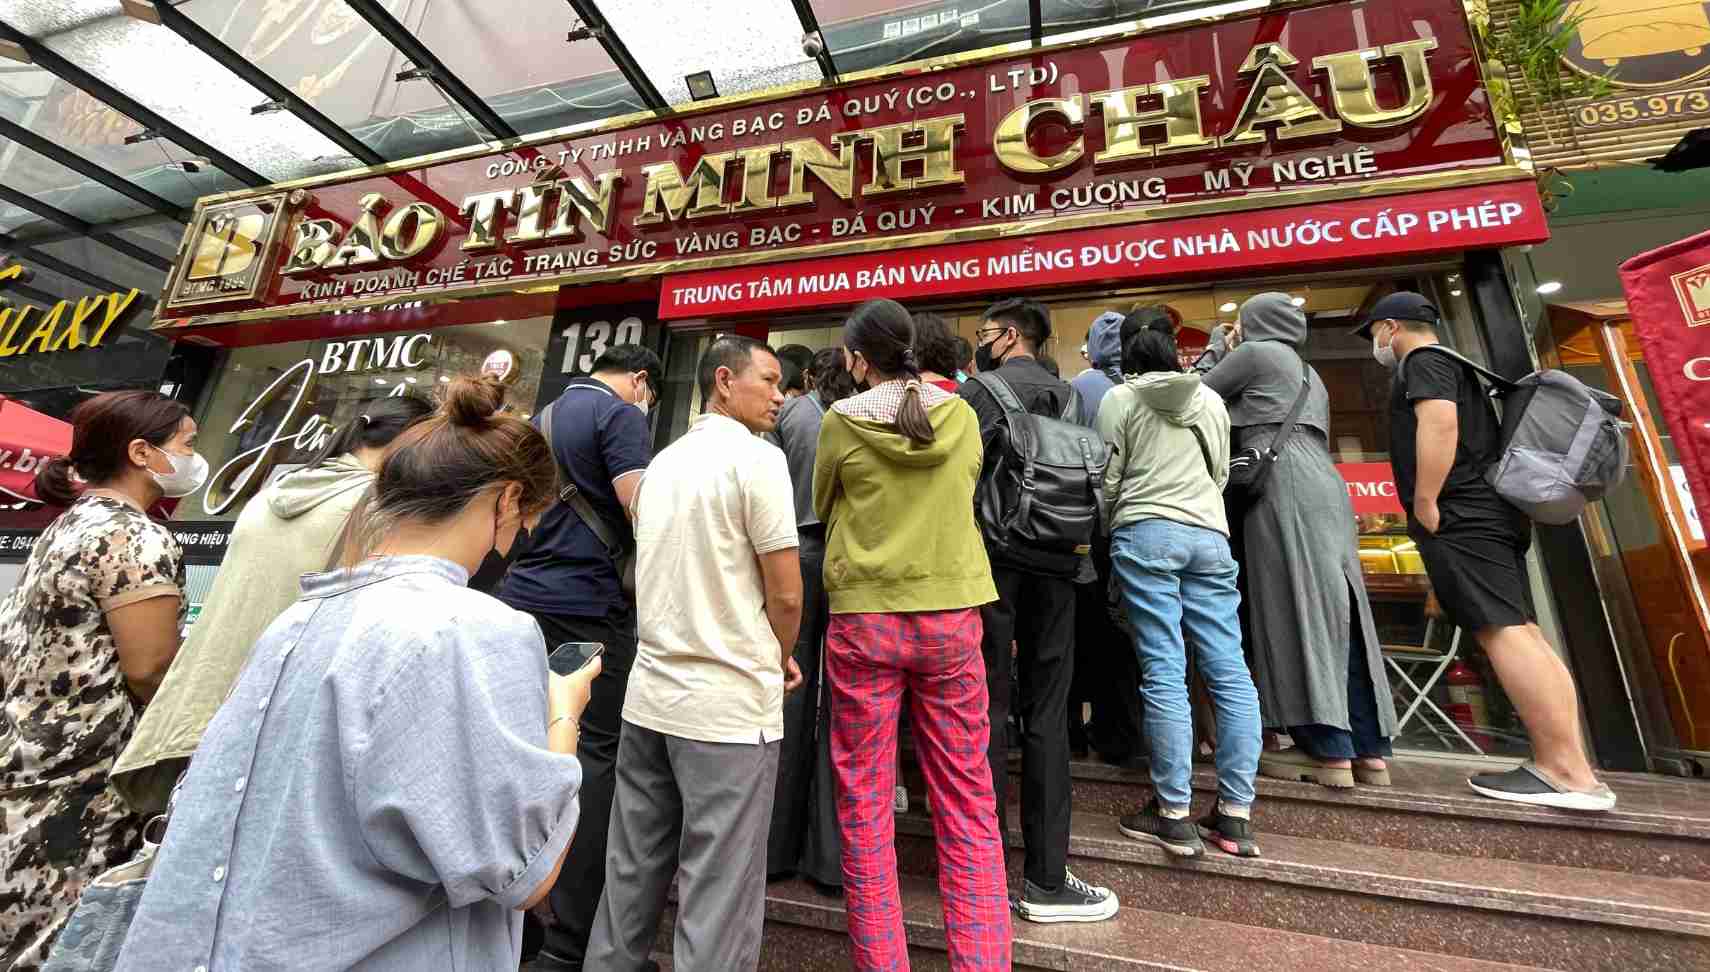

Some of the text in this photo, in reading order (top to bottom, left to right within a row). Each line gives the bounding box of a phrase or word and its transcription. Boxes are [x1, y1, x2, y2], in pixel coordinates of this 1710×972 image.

[280, 36, 1440, 276] BẢO TÍN MINH CHÂU
[558, 148, 584, 166] TY
[590, 135, 651, 161] TNHH
[659, 123, 724, 148] VÀNG
[731, 112, 785, 136] BẠC
[795, 100, 833, 125] ĐÁ
[842, 86, 901, 117] QUÝ
[988, 62, 1060, 93] LTD)
[1580, 91, 1709, 125] 035.973
[300, 281, 347, 300] KINH
[353, 270, 420, 294] DOANH
[426, 257, 469, 285] CHẾ
[475, 256, 513, 279] TÁC
[523, 248, 599, 272] TRANG
[608, 238, 657, 263] SỨC
[674, 231, 739, 254] VÀNG
[750, 223, 801, 248] BẠC
[831, 212, 867, 236] ĐÁ
[876, 202, 937, 231] QUÝ
[982, 191, 1036, 219] KIM
[1050, 176, 1167, 211] CƯƠNG
[1203, 161, 1255, 192] MỸ
[1271, 145, 1378, 183] NGHỆ
[672, 200, 1522, 306] TRUNG TÂM MUA BÁN VÀNG MIẾNG ĐƯỢC NHÀ NƯỚC CẤP PHÉP
[318, 333, 432, 375] BTMC
[1345, 481, 1394, 497] TMC
